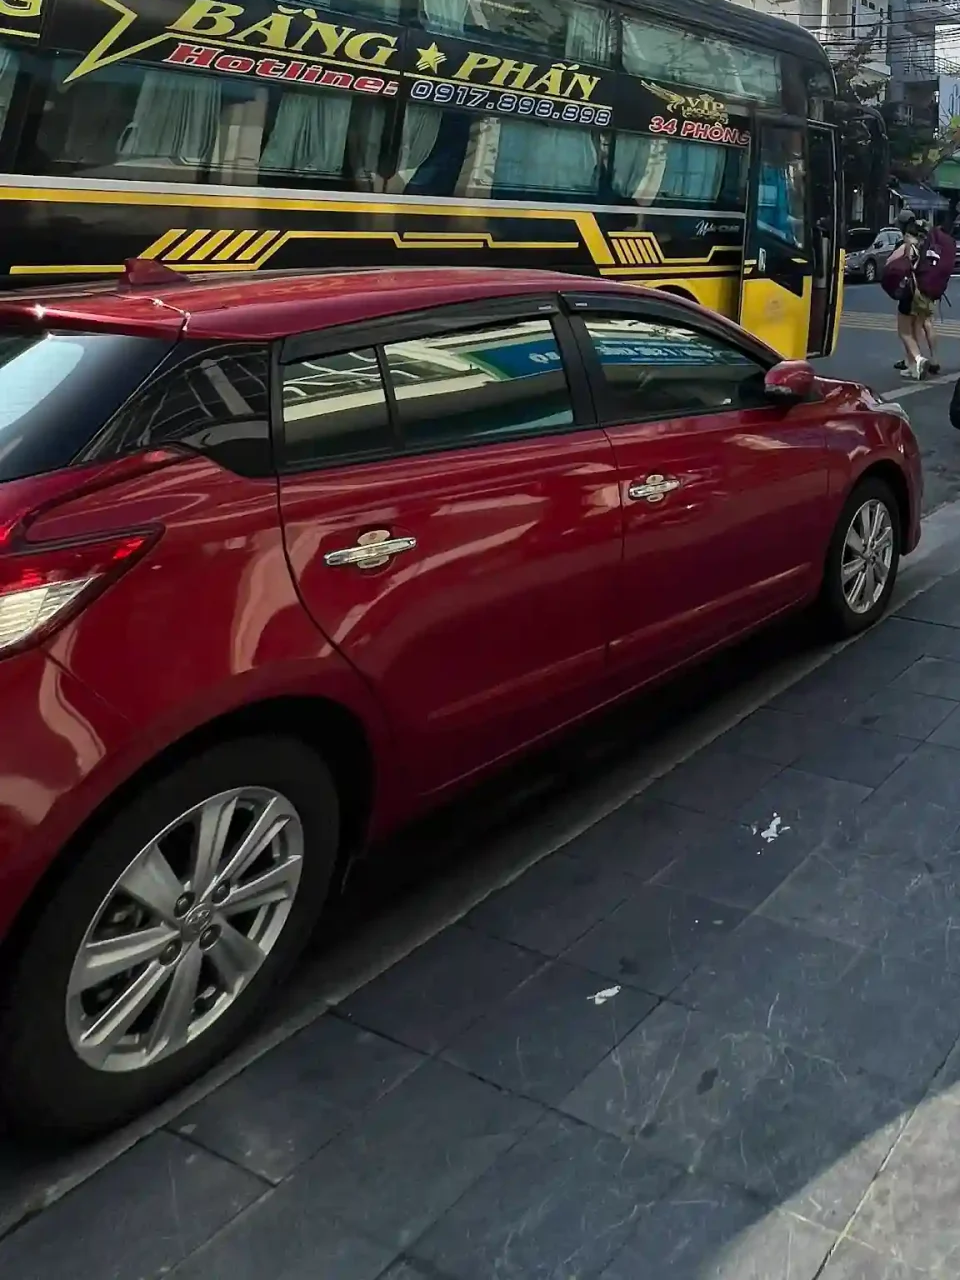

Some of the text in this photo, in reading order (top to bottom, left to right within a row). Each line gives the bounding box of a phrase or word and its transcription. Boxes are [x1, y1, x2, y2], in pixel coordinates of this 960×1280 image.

[162, 42, 613, 126] Hotline: 0917.898.898
[452, 51, 602, 101] PHẤN
[686, 96, 725, 113] VIP
[649, 116, 678, 135] 34
